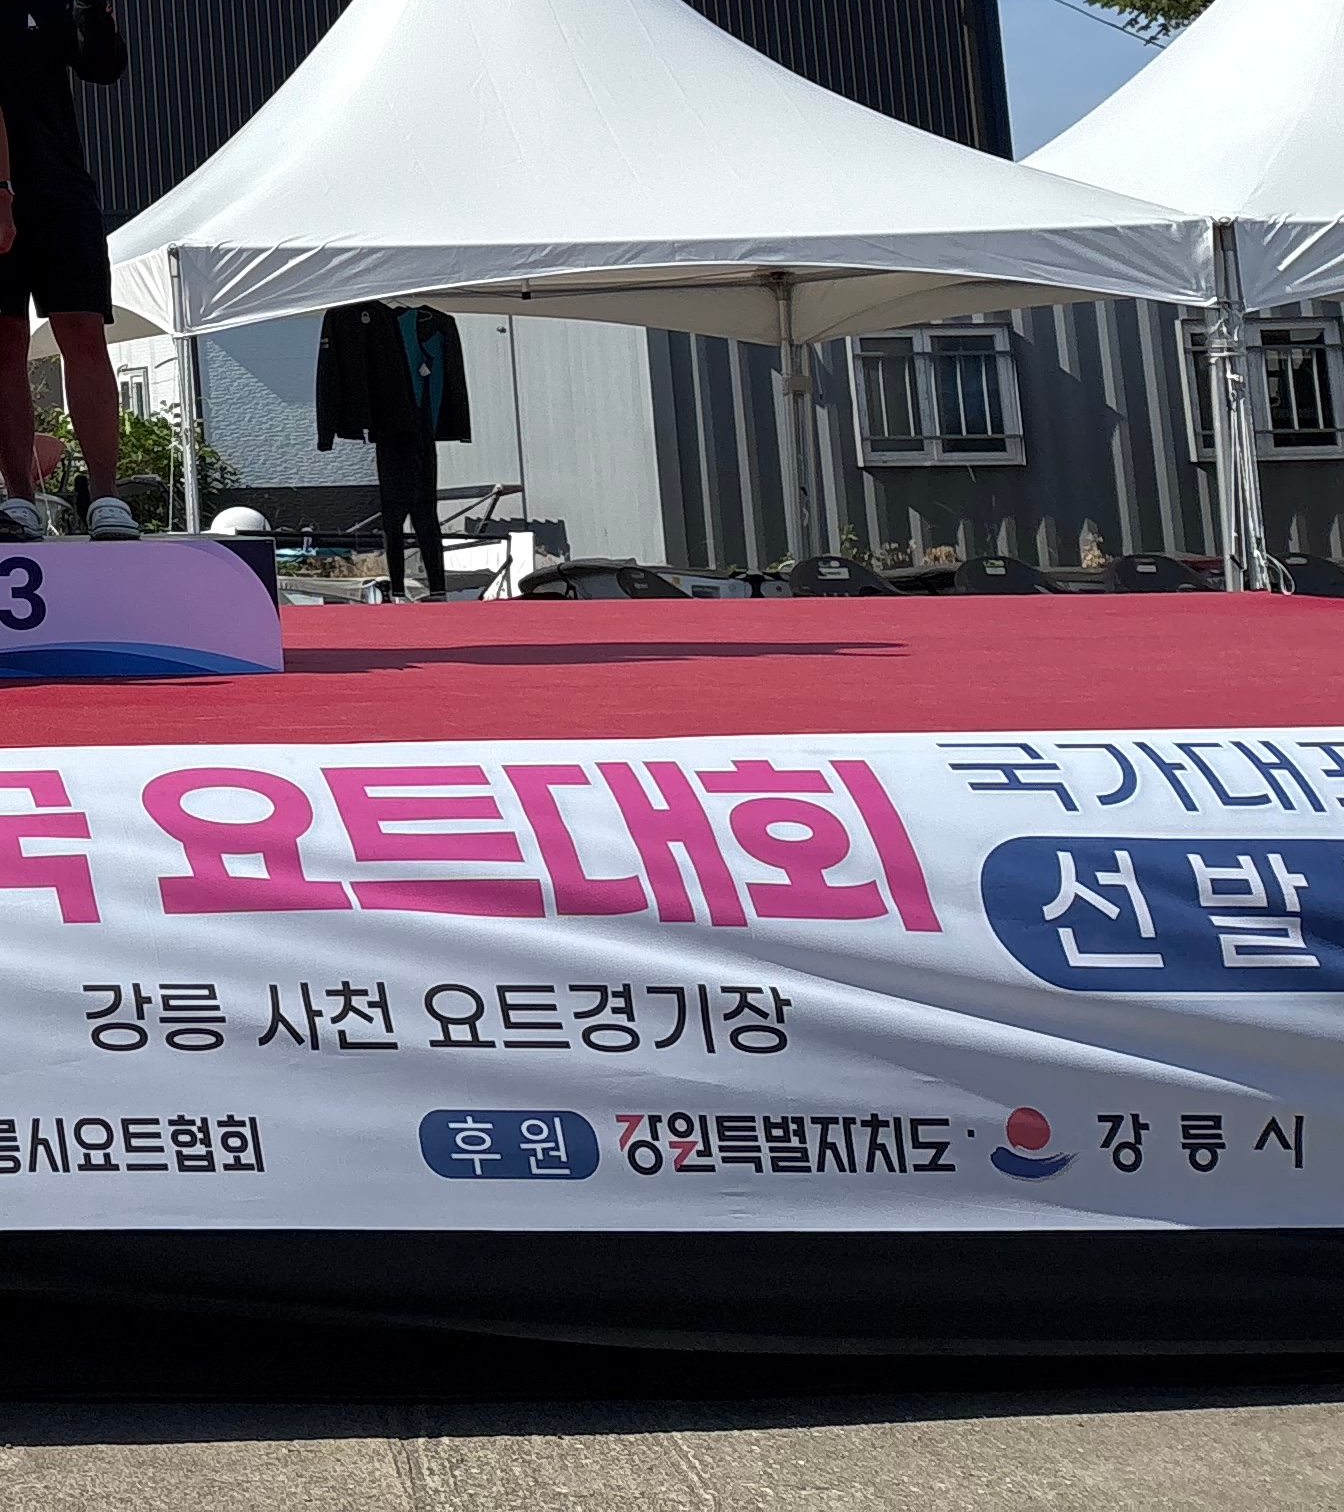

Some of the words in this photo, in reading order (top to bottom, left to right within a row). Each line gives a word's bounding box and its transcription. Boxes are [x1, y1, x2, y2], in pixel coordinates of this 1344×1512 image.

[140, 759, 944, 932] 요트대회
[82, 982, 228, 1052] 강릉
[257, 980, 399, 1052] 사천
[426, 982, 793, 1055] 요트경기장
[616, 1111, 957, 1176] 강원특별자치도
